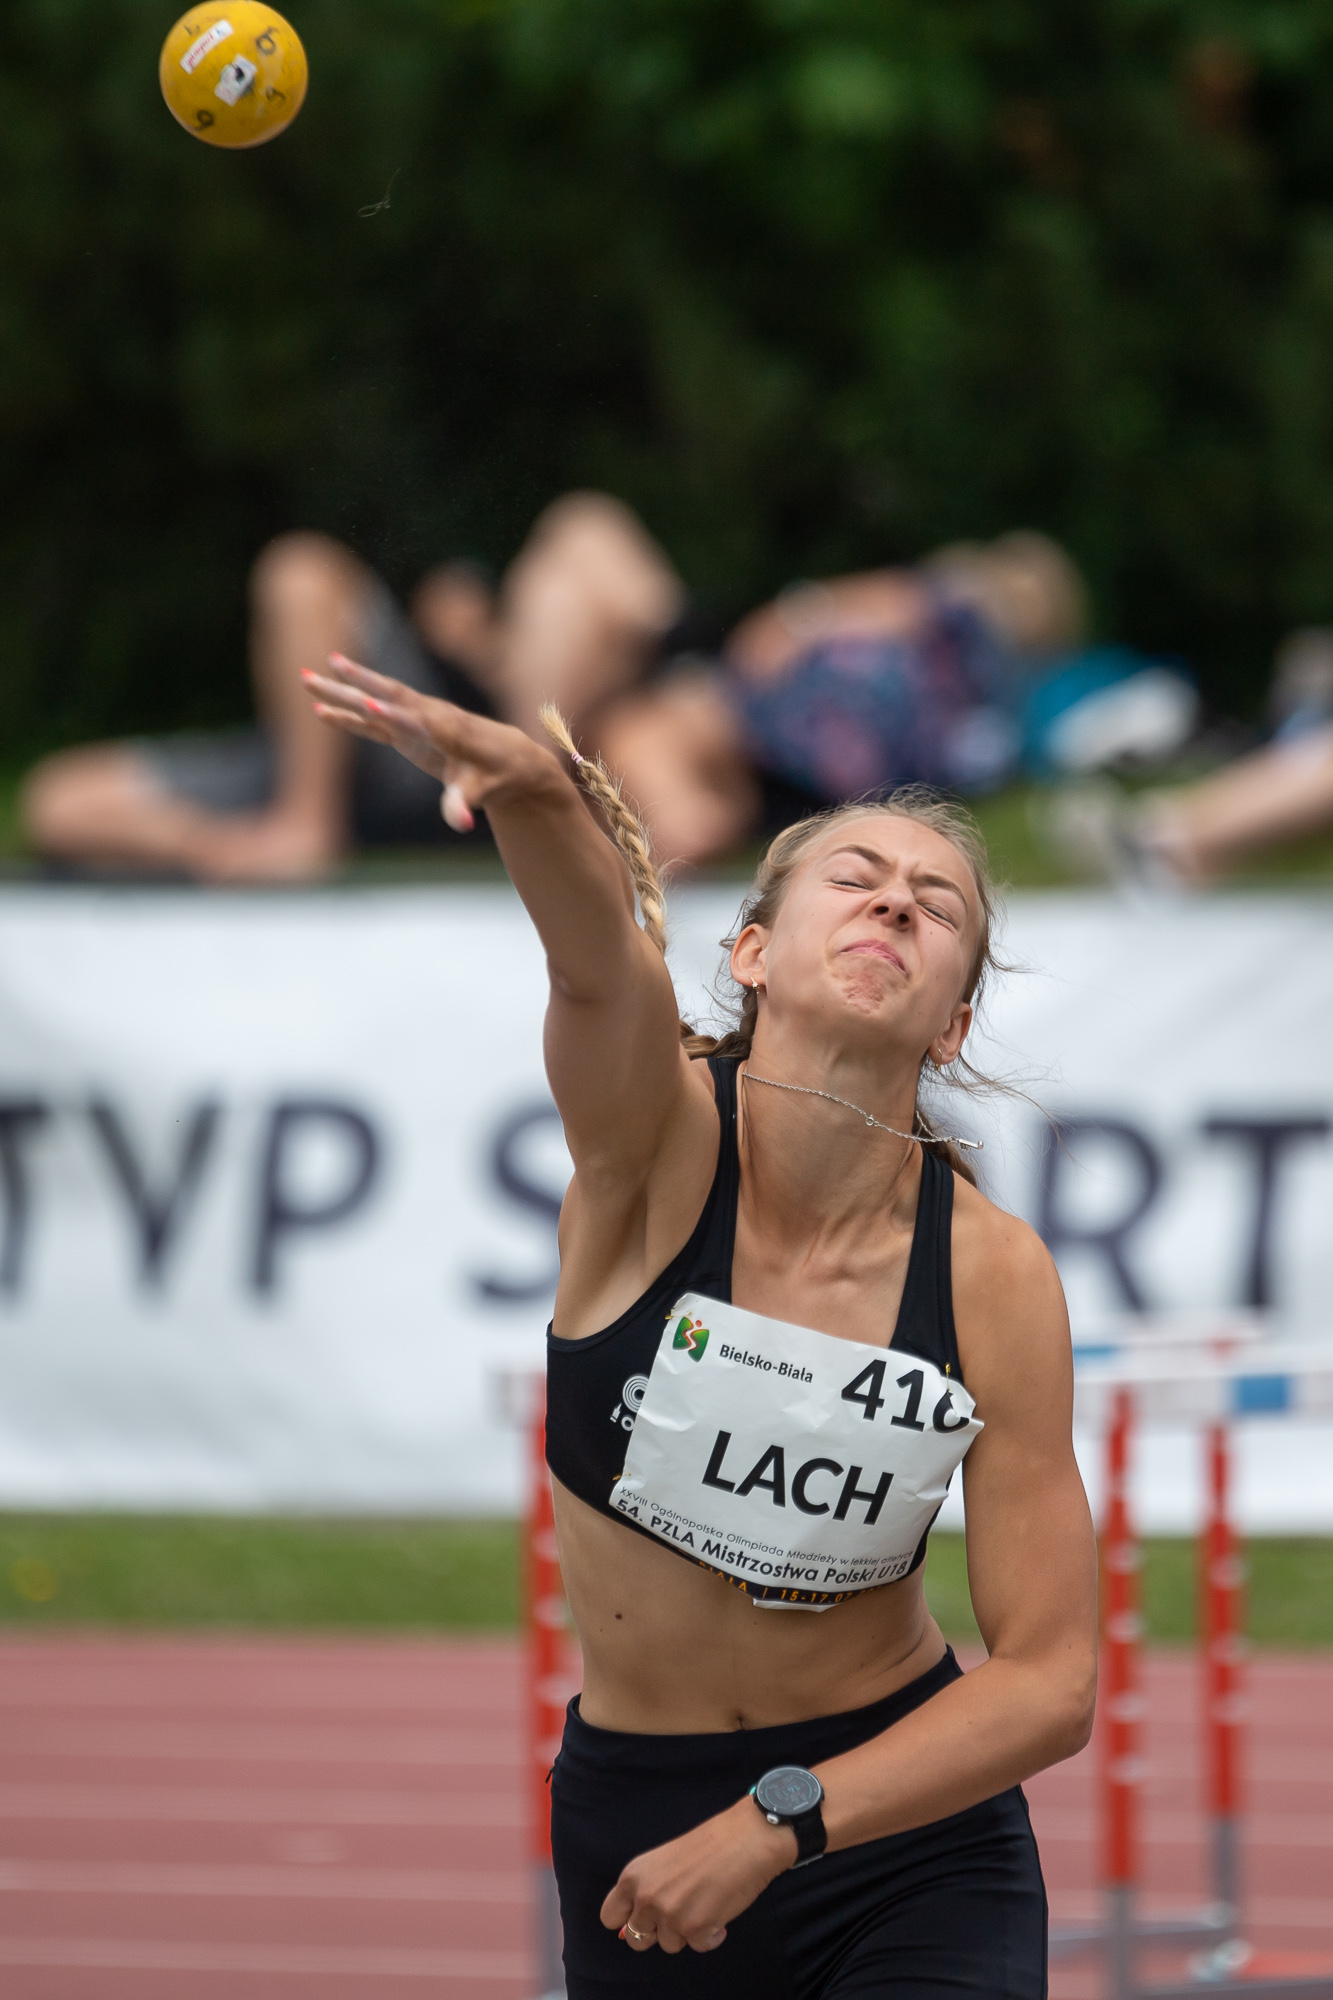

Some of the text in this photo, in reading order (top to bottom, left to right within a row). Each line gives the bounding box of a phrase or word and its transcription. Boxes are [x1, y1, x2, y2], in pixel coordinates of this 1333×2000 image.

[470, 1098, 1331, 1308] SRT
[719, 1344, 814, 1384] Bielsko-Biała
[701, 1430, 894, 1525] LACH
[616, 1498, 908, 1585] 54. PZLA Mistrzostwa Polski U18
[619, 1486, 648, 1507] XXVIII
[650, 1502, 724, 1539] Ogólnopolska
[726, 1533, 784, 1557] Olimpiada
[786, 1550, 838, 1565] Młodzieży
[840, 1558, 849, 1566] w
[850, 1557, 879, 1567] lekkiej
